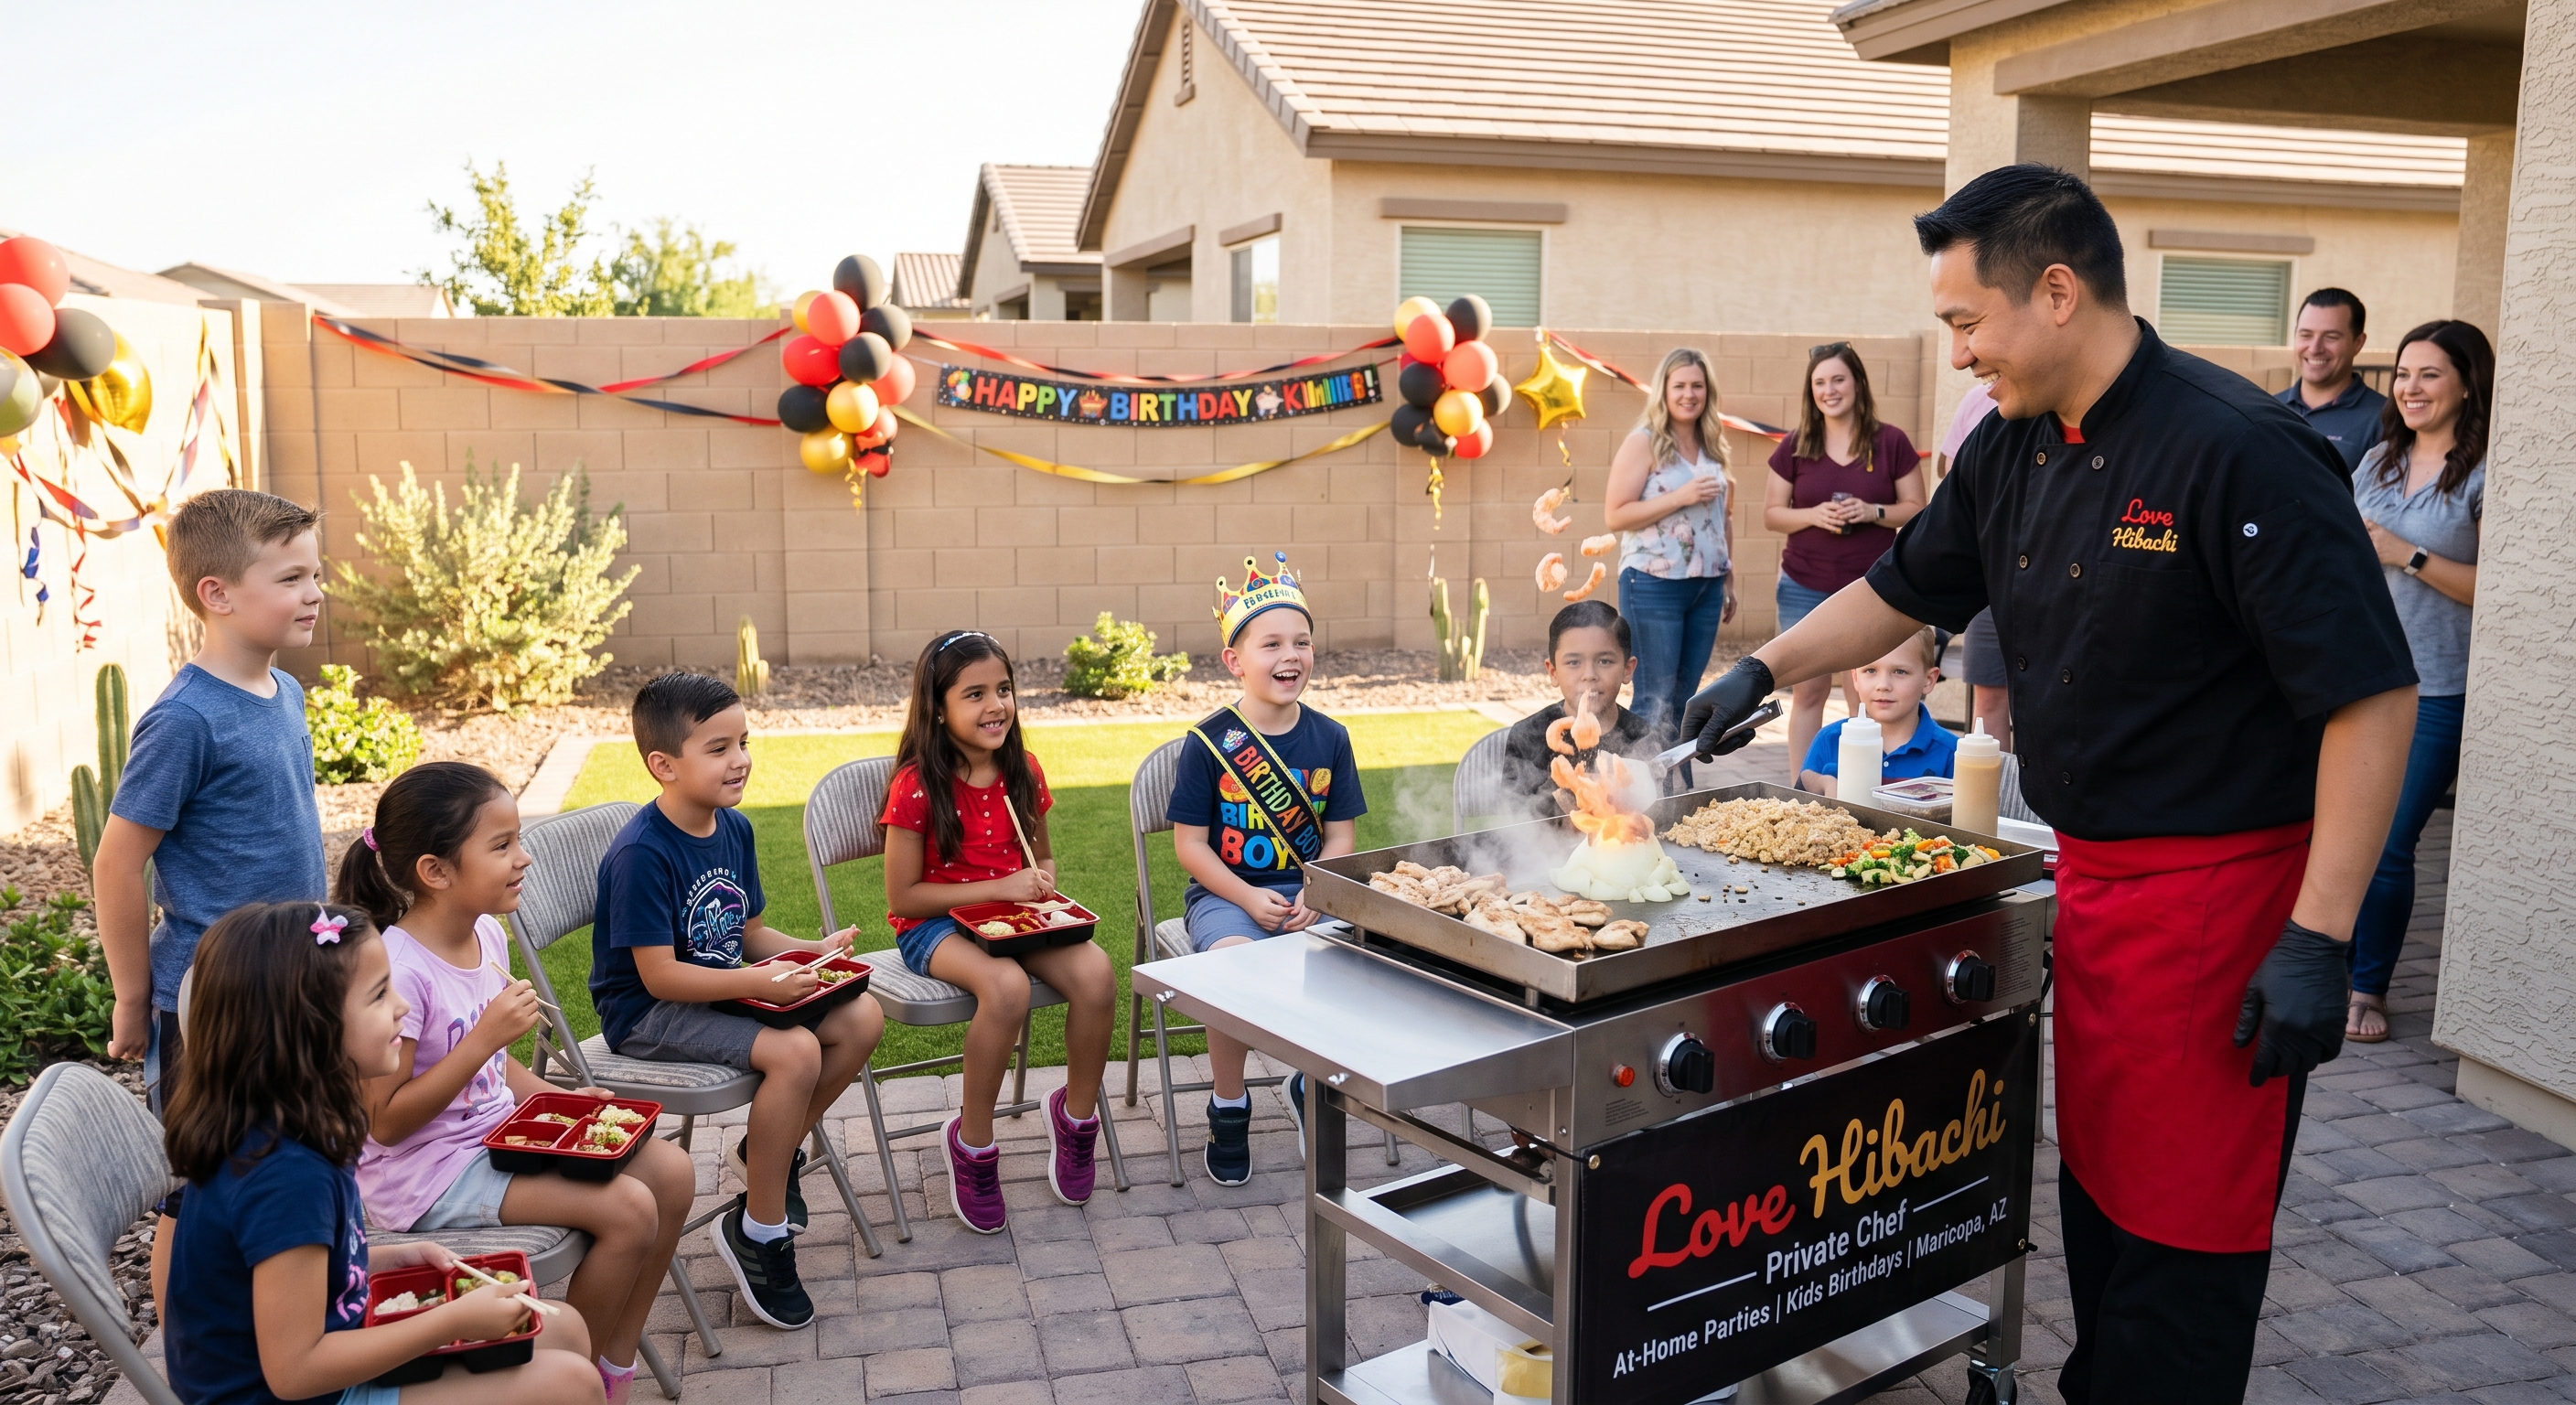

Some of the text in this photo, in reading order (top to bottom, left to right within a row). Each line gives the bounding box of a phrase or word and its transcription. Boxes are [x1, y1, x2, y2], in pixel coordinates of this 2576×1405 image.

[973, 376, 1079, 417] HAPPY
[1110, 389, 1253, 422] BIRTHDAY
[2111, 526, 2179, 552] Hibachi
[2120, 498, 2174, 527] Love
[1233, 745, 1309, 834] BIRTHDAY
[1220, 826, 1290, 871] BOY
[1627, 1068, 2007, 1279] Love Hibachi
[1766, 1197, 1908, 1285] Private Chef
[1613, 1330, 1699, 1379] At-Home
[1704, 1305, 1770, 1345] Parties
[1786, 1281, 1824, 1314] Kids
[1828, 1254, 1903, 1297] Birthdays
[1916, 1215, 1985, 1259] Maricopa,
[1989, 1196, 2008, 1226] AZ
